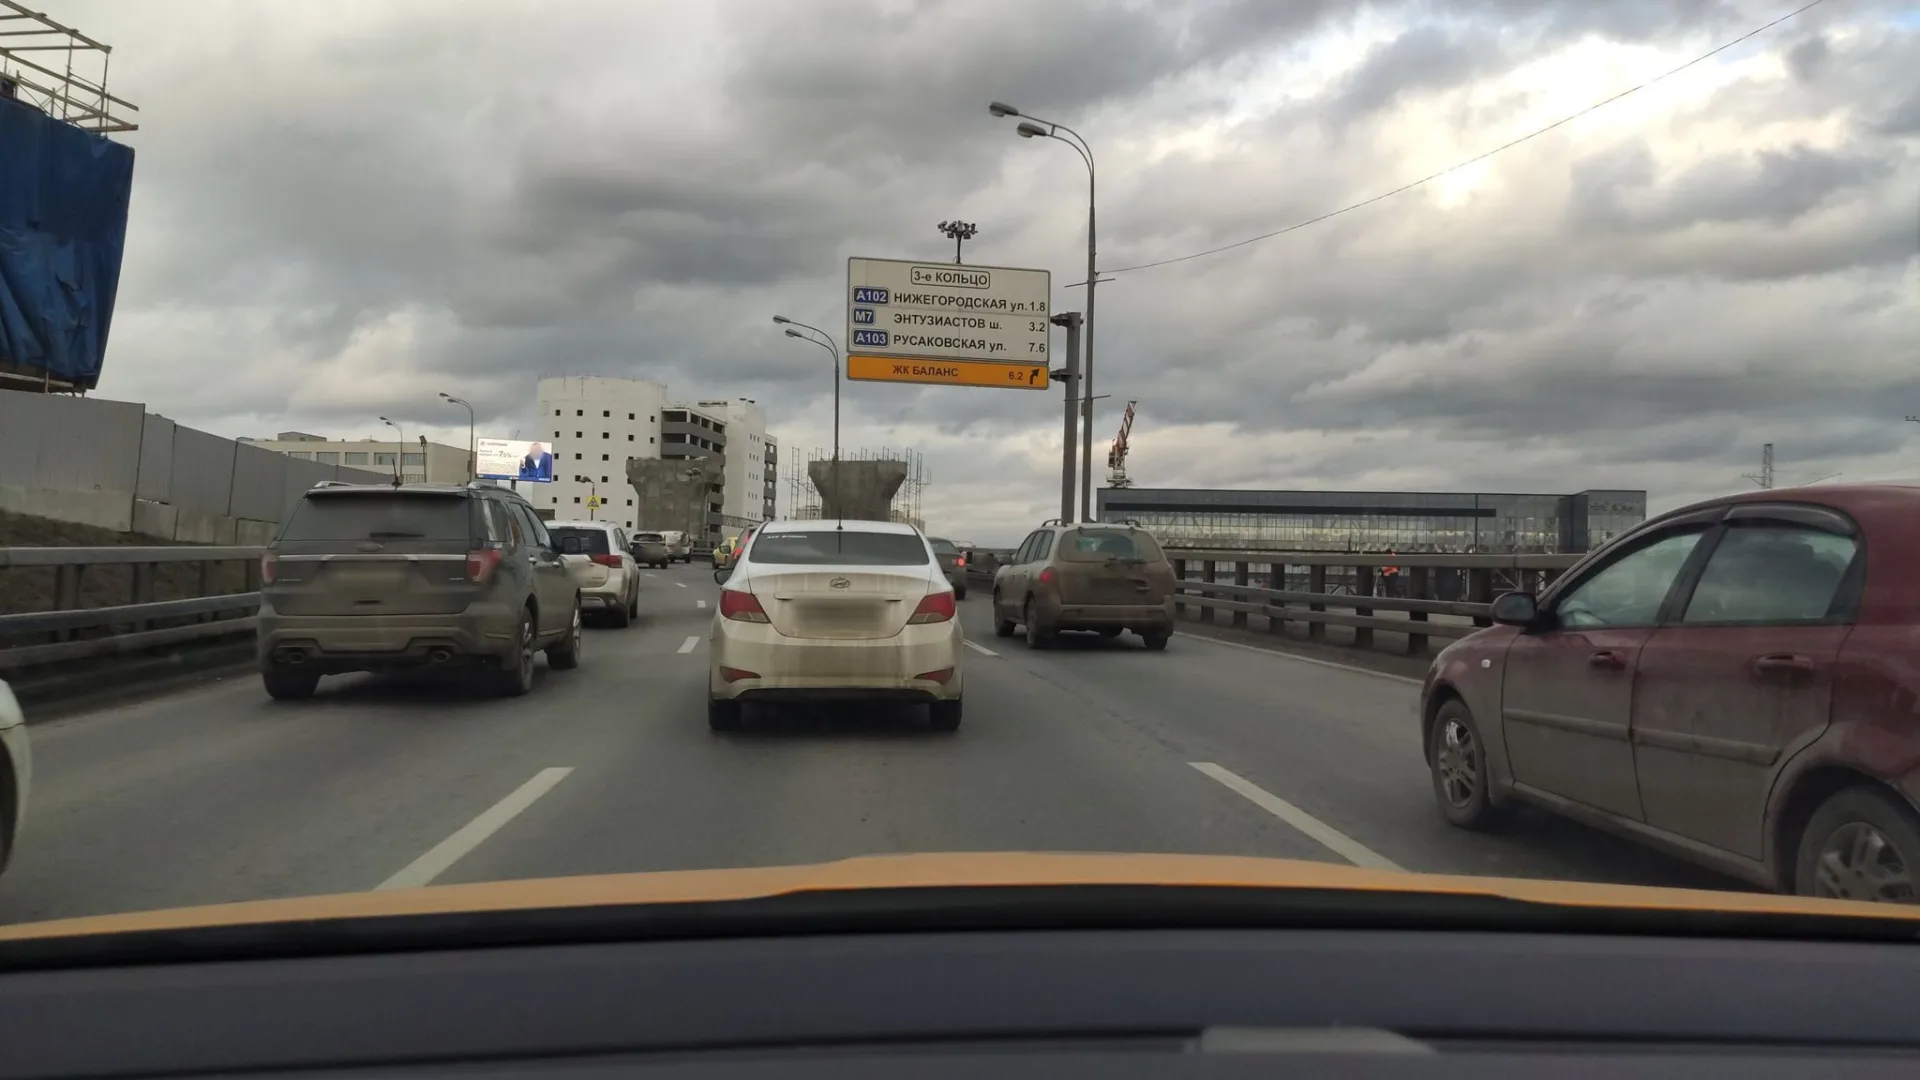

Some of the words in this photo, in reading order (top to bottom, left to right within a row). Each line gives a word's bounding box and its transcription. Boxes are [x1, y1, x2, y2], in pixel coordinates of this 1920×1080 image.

[914, 271, 932, 282] 3-е
[935, 272, 988, 286] КОЛЬЦО
[894, 292, 1007, 310] НИЖЕГОРОДСКАЯ
[1010, 302, 1028, 312] ул.
[1030, 301, 1046, 312] 1.8
[894, 313, 986, 329] ЭНТУЗИАСТОВ
[989, 322, 1002, 330] ш.
[1028, 321, 1045, 332] 3.2
[893, 334, 986, 350] РУСАКОВСКАЯ
[989, 342, 1007, 352] ул.
[1028, 342, 1045, 353] 7.6
[892, 365, 909, 375] ЖК
[912, 366, 959, 377] БАЛАНС
[1008, 371, 1023, 381] 6.2
